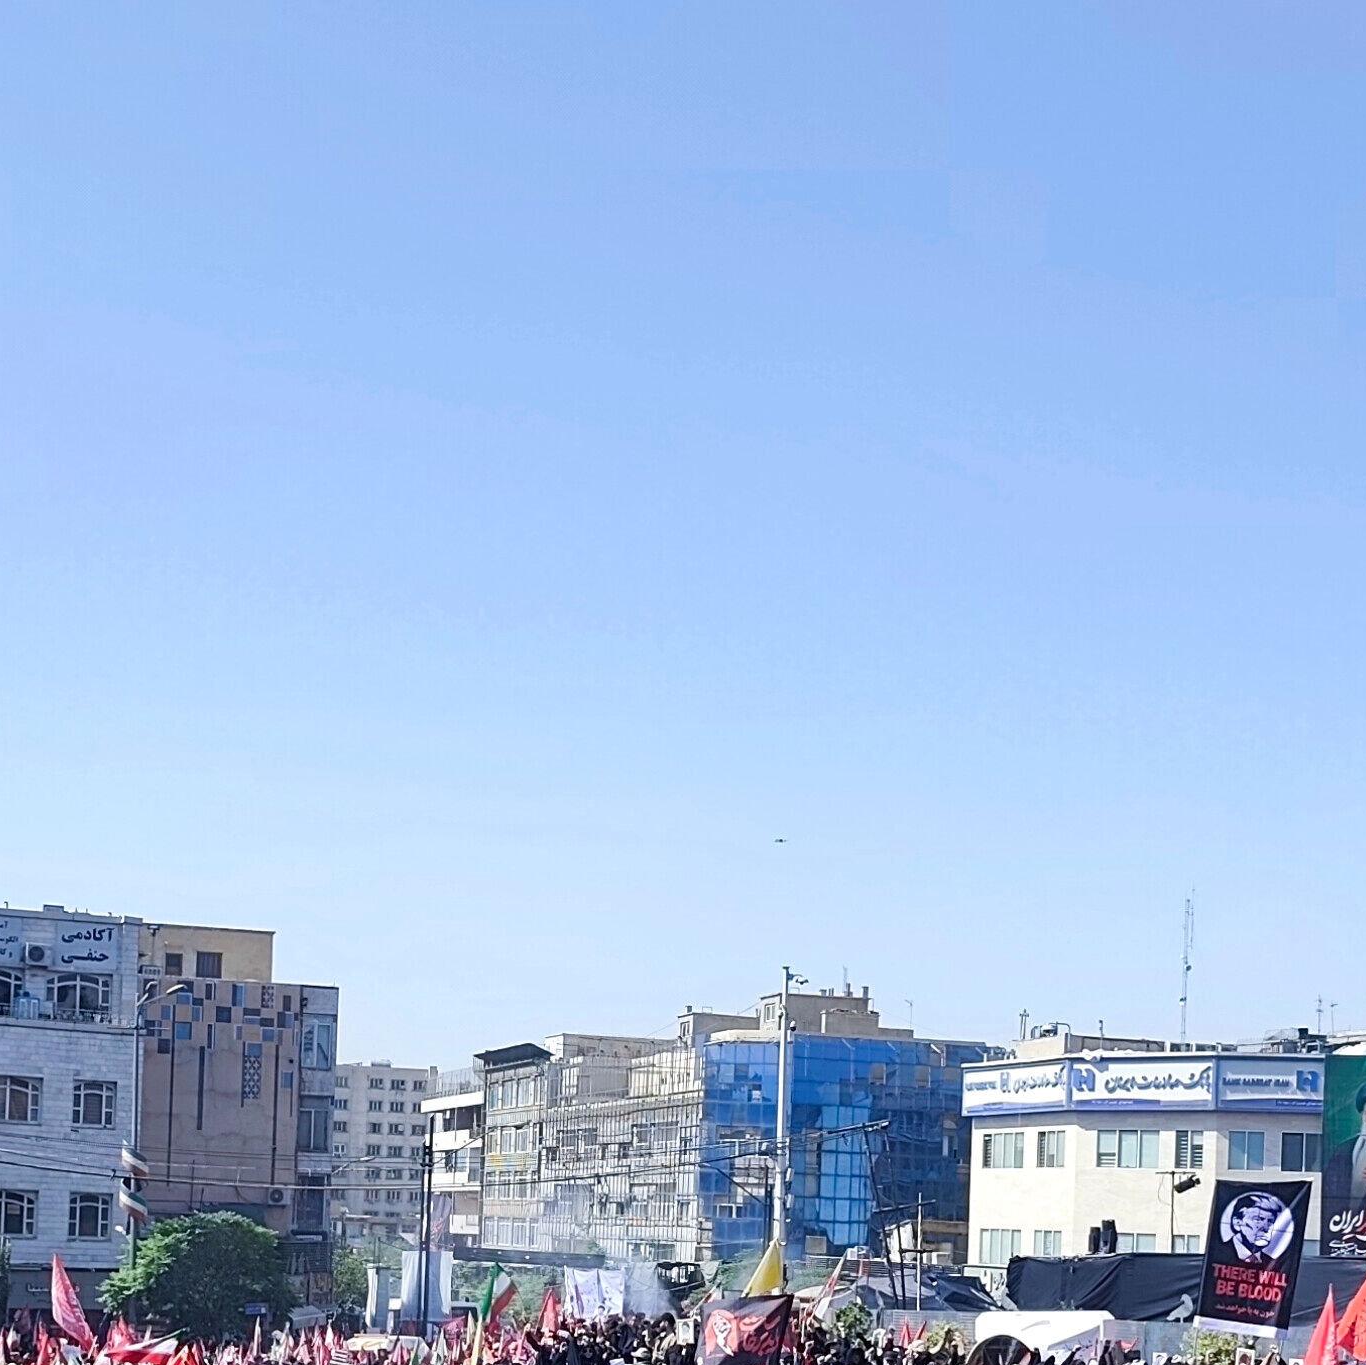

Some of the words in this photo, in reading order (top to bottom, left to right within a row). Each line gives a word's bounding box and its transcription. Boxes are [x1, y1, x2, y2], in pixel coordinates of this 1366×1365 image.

[61, 926, 115, 944] آکادمی
[61, 949, 110, 963] حنفی
[1104, 1076, 1135, 1094] ایران
[1136, 1073, 1183, 1090] صادرات
[1182, 1066, 1212, 1094] بانک
[1329, 1210, 1365, 1234] ایران
[1212, 1263, 1256, 1282] THERE
[1258, 1270, 1288, 1287] WILL
[1215, 1279, 1235, 1296] BE
[1238, 1283, 1282, 1302] BLOOD
